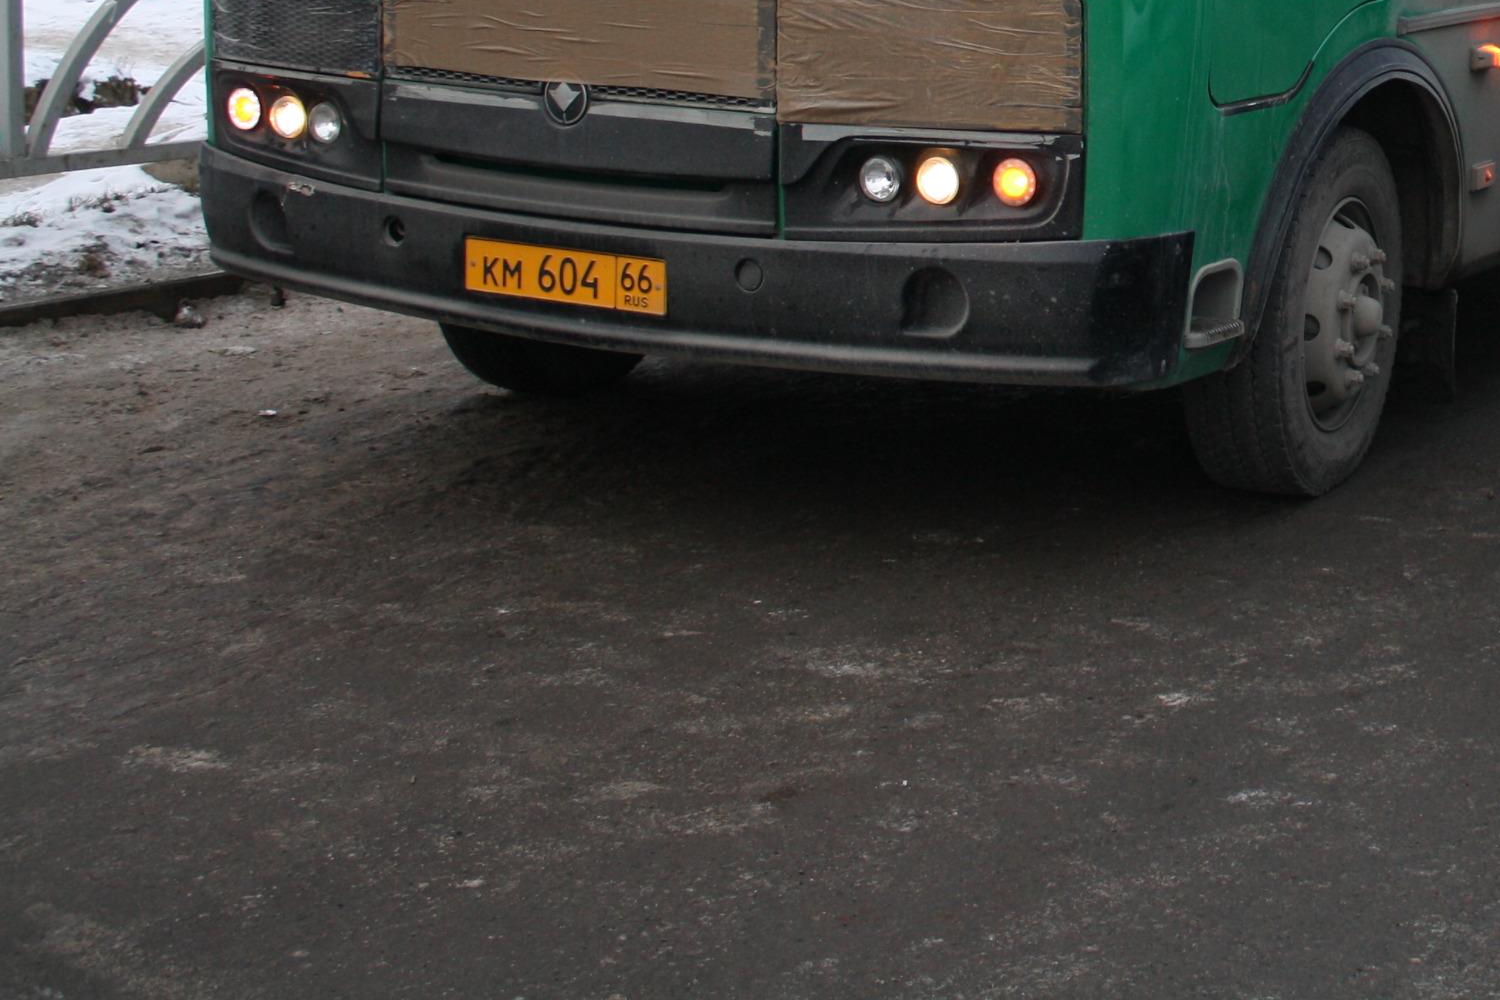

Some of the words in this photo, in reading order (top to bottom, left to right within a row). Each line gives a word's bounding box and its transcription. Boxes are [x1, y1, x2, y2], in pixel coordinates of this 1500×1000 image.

[538, 255, 598, 299] 604
[621, 262, 653, 294] 66
[624, 294, 649, 308] RUS
